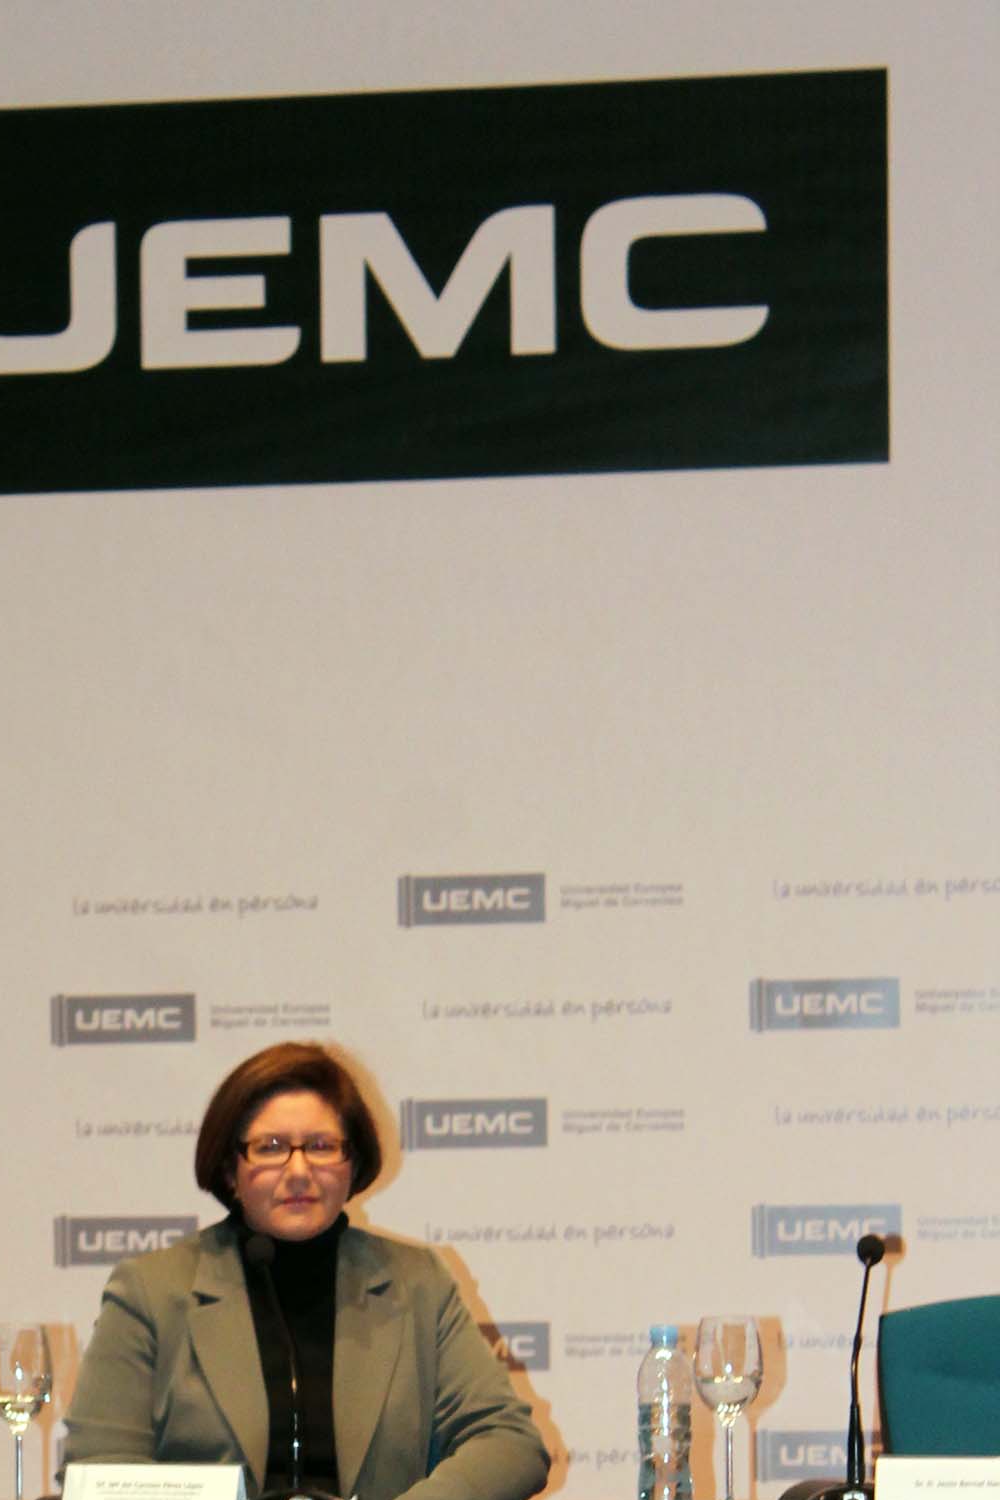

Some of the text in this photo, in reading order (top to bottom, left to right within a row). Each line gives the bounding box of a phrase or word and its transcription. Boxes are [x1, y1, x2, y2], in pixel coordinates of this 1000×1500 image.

[423, 888, 531, 912] UEMC
[775, 991, 883, 1015] UEMC
[75, 1005, 181, 1030] UEMC
[425, 1112, 533, 1136] UEMC
